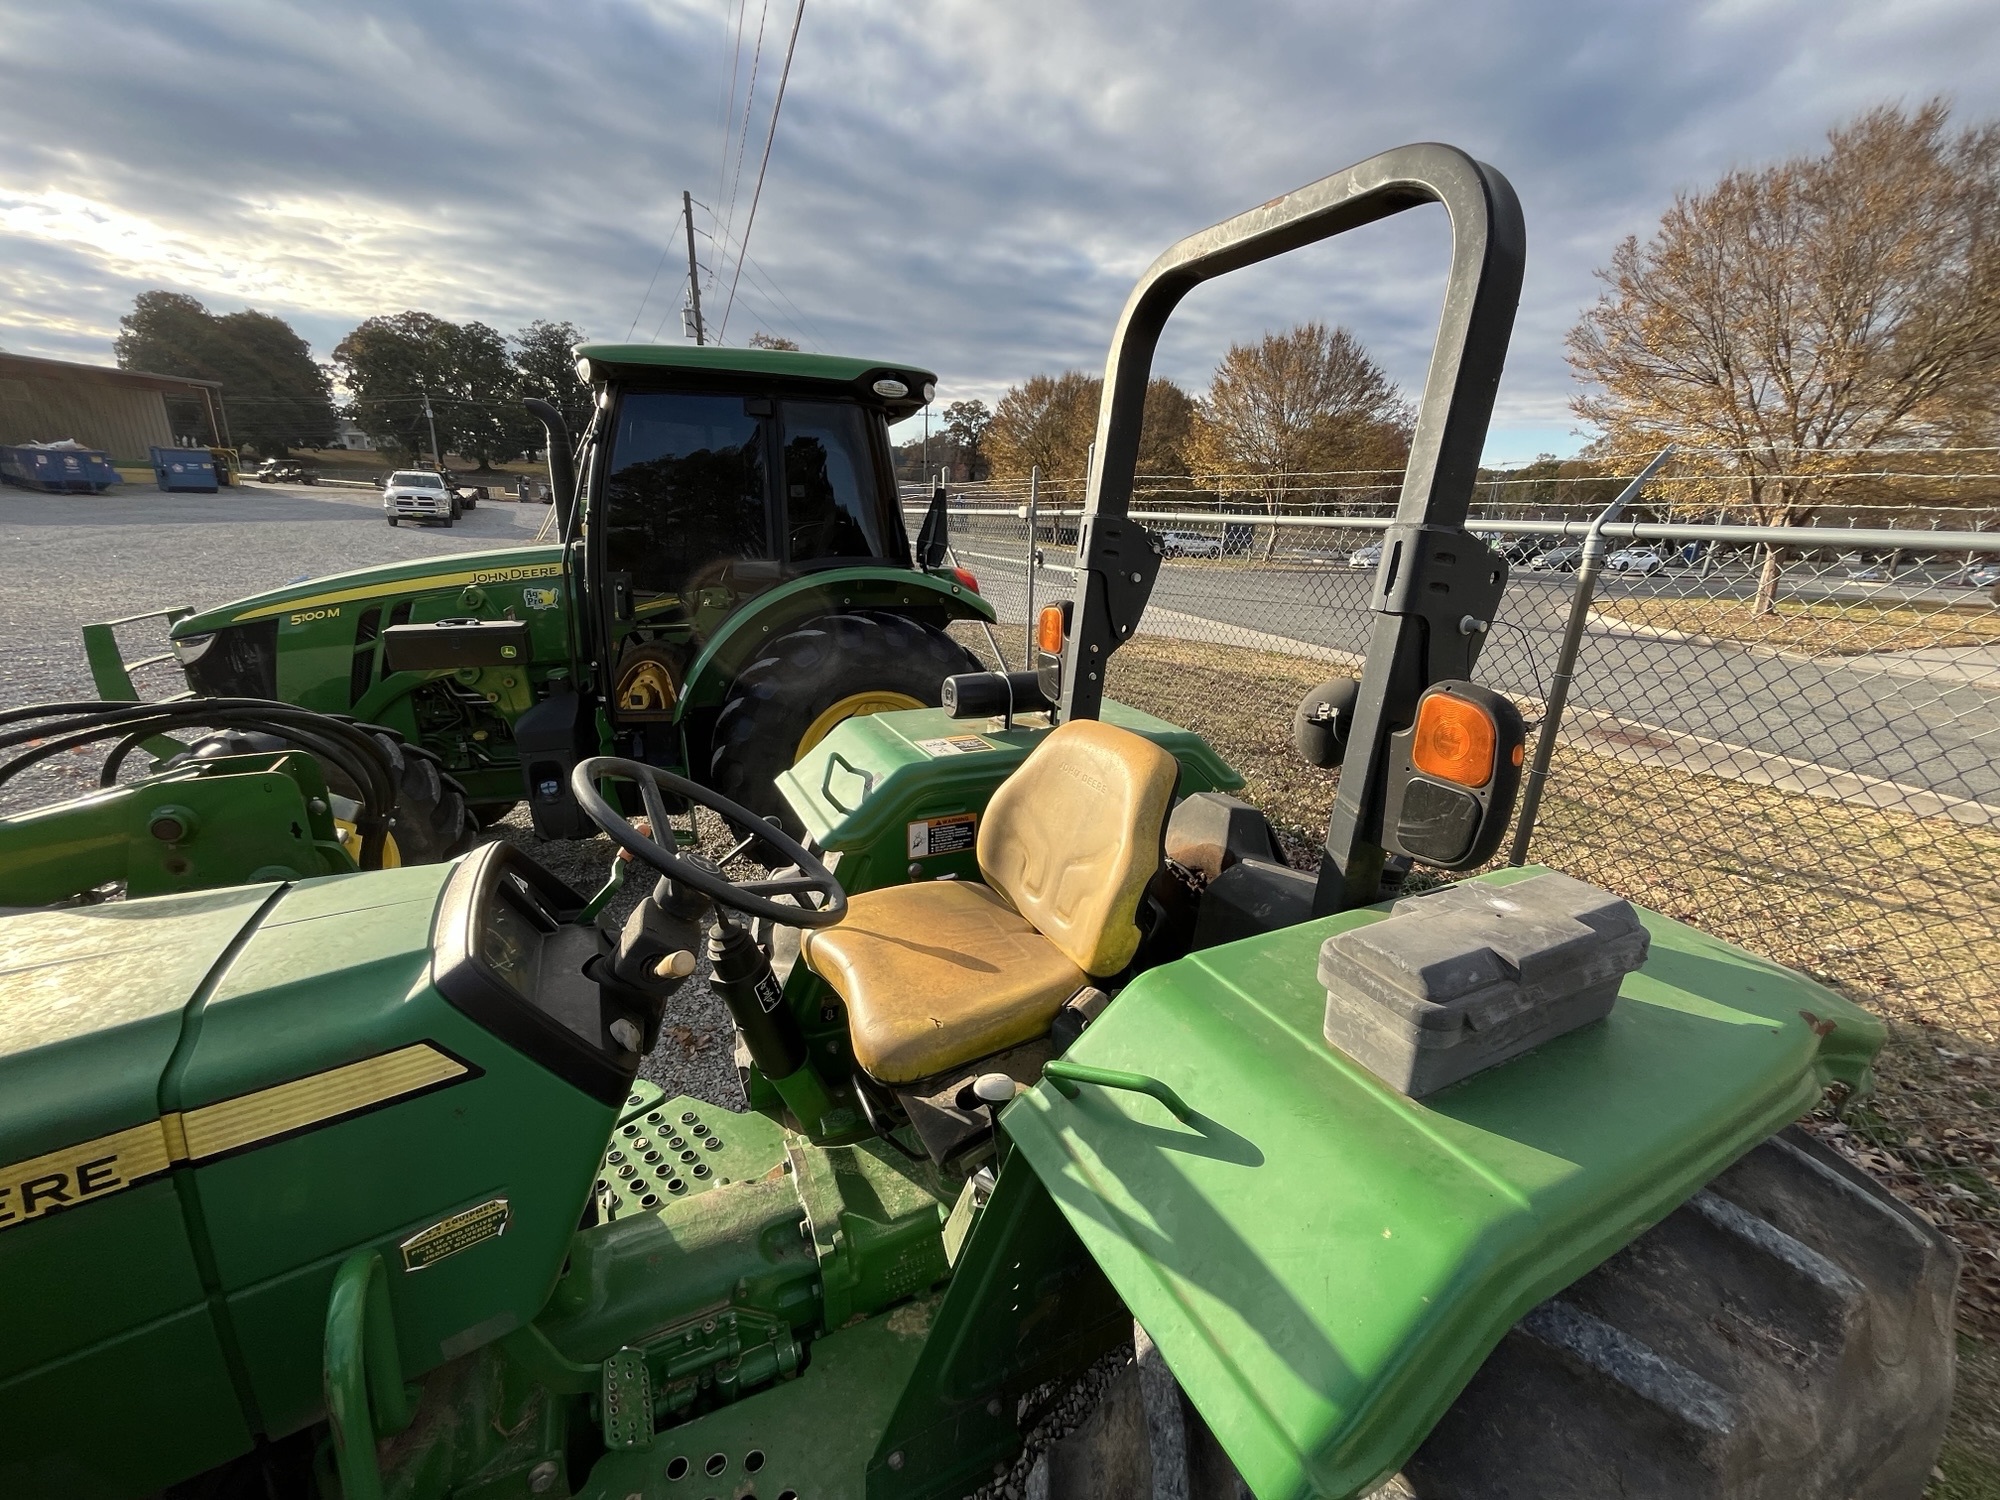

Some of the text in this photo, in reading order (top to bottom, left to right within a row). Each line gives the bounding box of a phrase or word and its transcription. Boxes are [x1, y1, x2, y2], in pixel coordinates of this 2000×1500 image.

[469, 566, 558, 584] JOHN DEERE
[1058, 761, 1107, 794] JOHN DEERE
[942, 816, 969, 825] WARNING
[445, 1202, 497, 1228] EQUIPMEN
[411, 1244, 431, 1256] PICK
[433, 1237, 446, 1247] UP
[446, 1230, 463, 1242] AND
[464, 1212, 503, 1234] DELIVERY
[422, 1245, 452, 1262] UNDER
[453, 1225, 498, 1248] WARRANTY
[436, 1240, 454, 1251] NOT
[455, 1222, 493, 1243] COVERED
